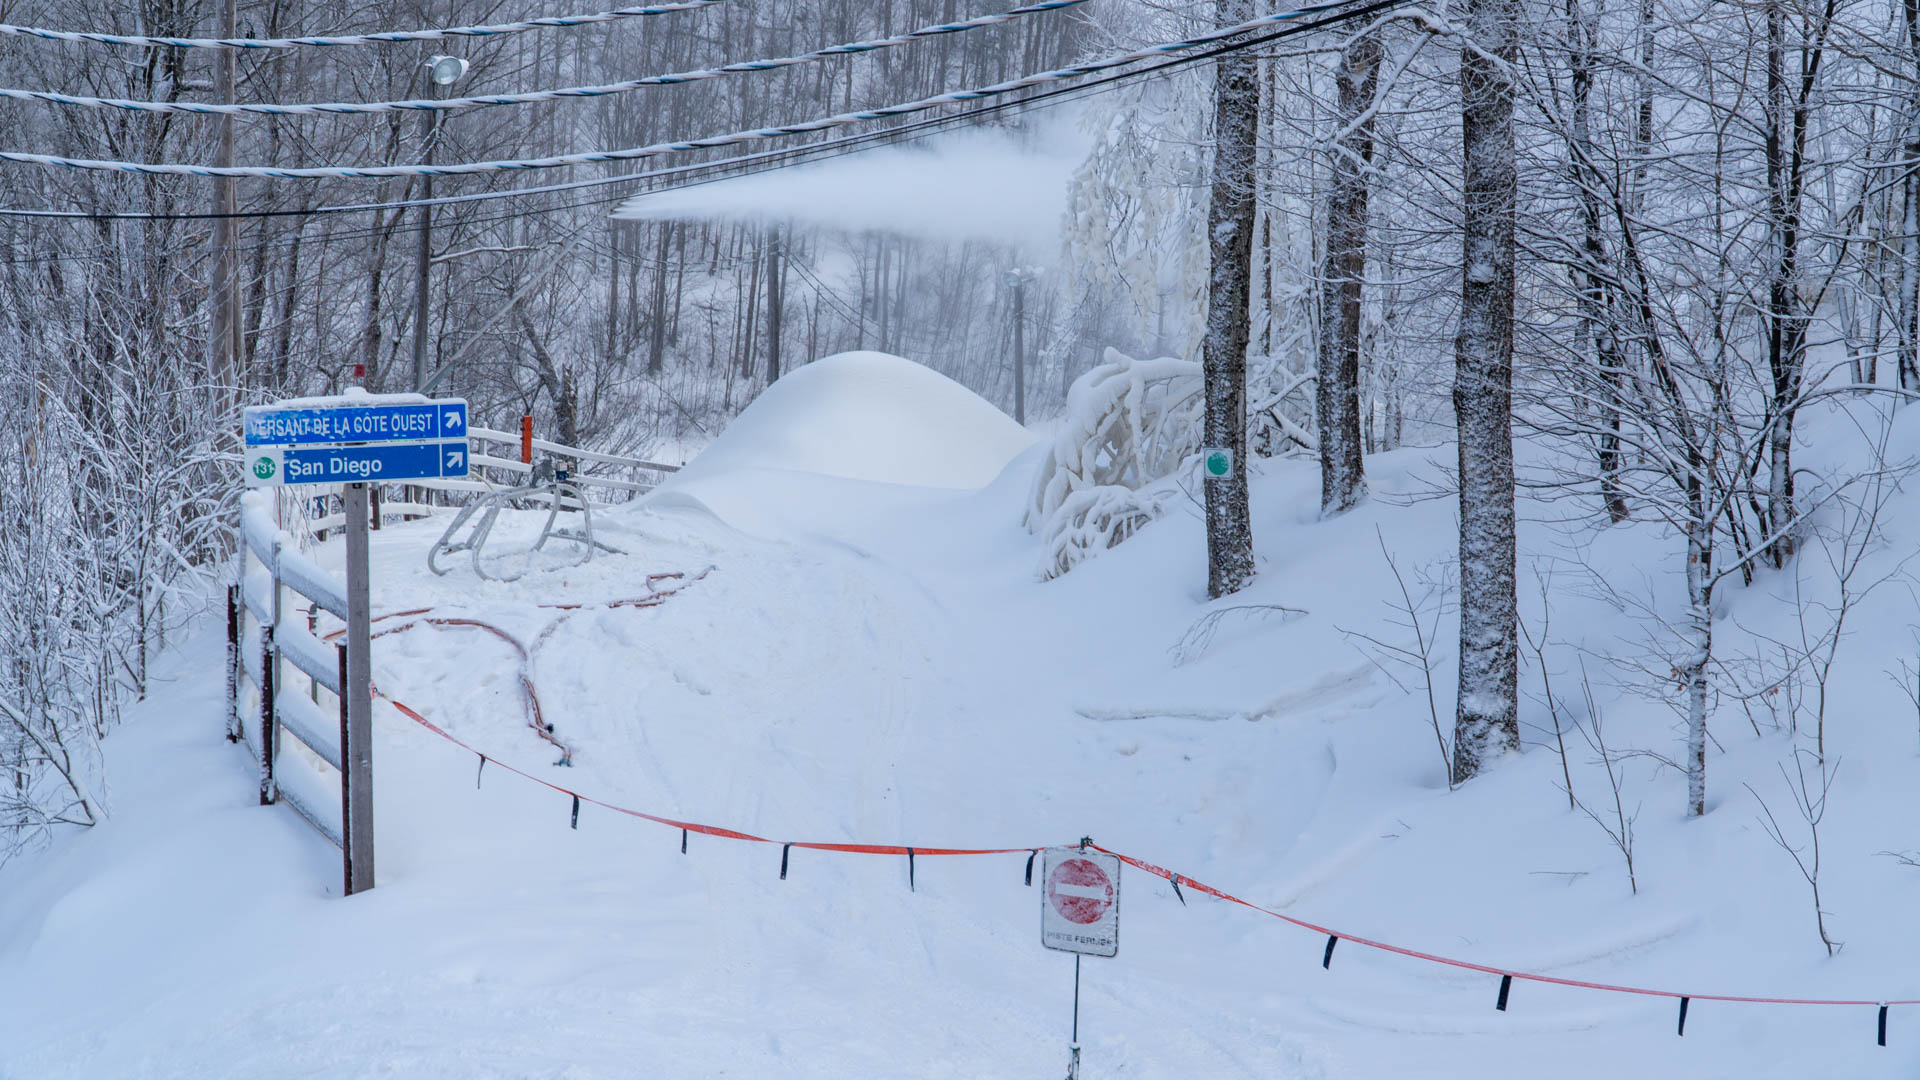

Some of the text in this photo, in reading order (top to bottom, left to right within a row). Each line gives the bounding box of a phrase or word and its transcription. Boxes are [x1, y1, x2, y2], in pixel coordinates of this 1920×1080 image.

[250, 411, 433, 437] VERSANT DE LA CÔTE OUEST
[255, 462, 275, 475] 131
[289, 456, 382, 477] San Diego
[1047, 931, 1073, 942] PISTE
